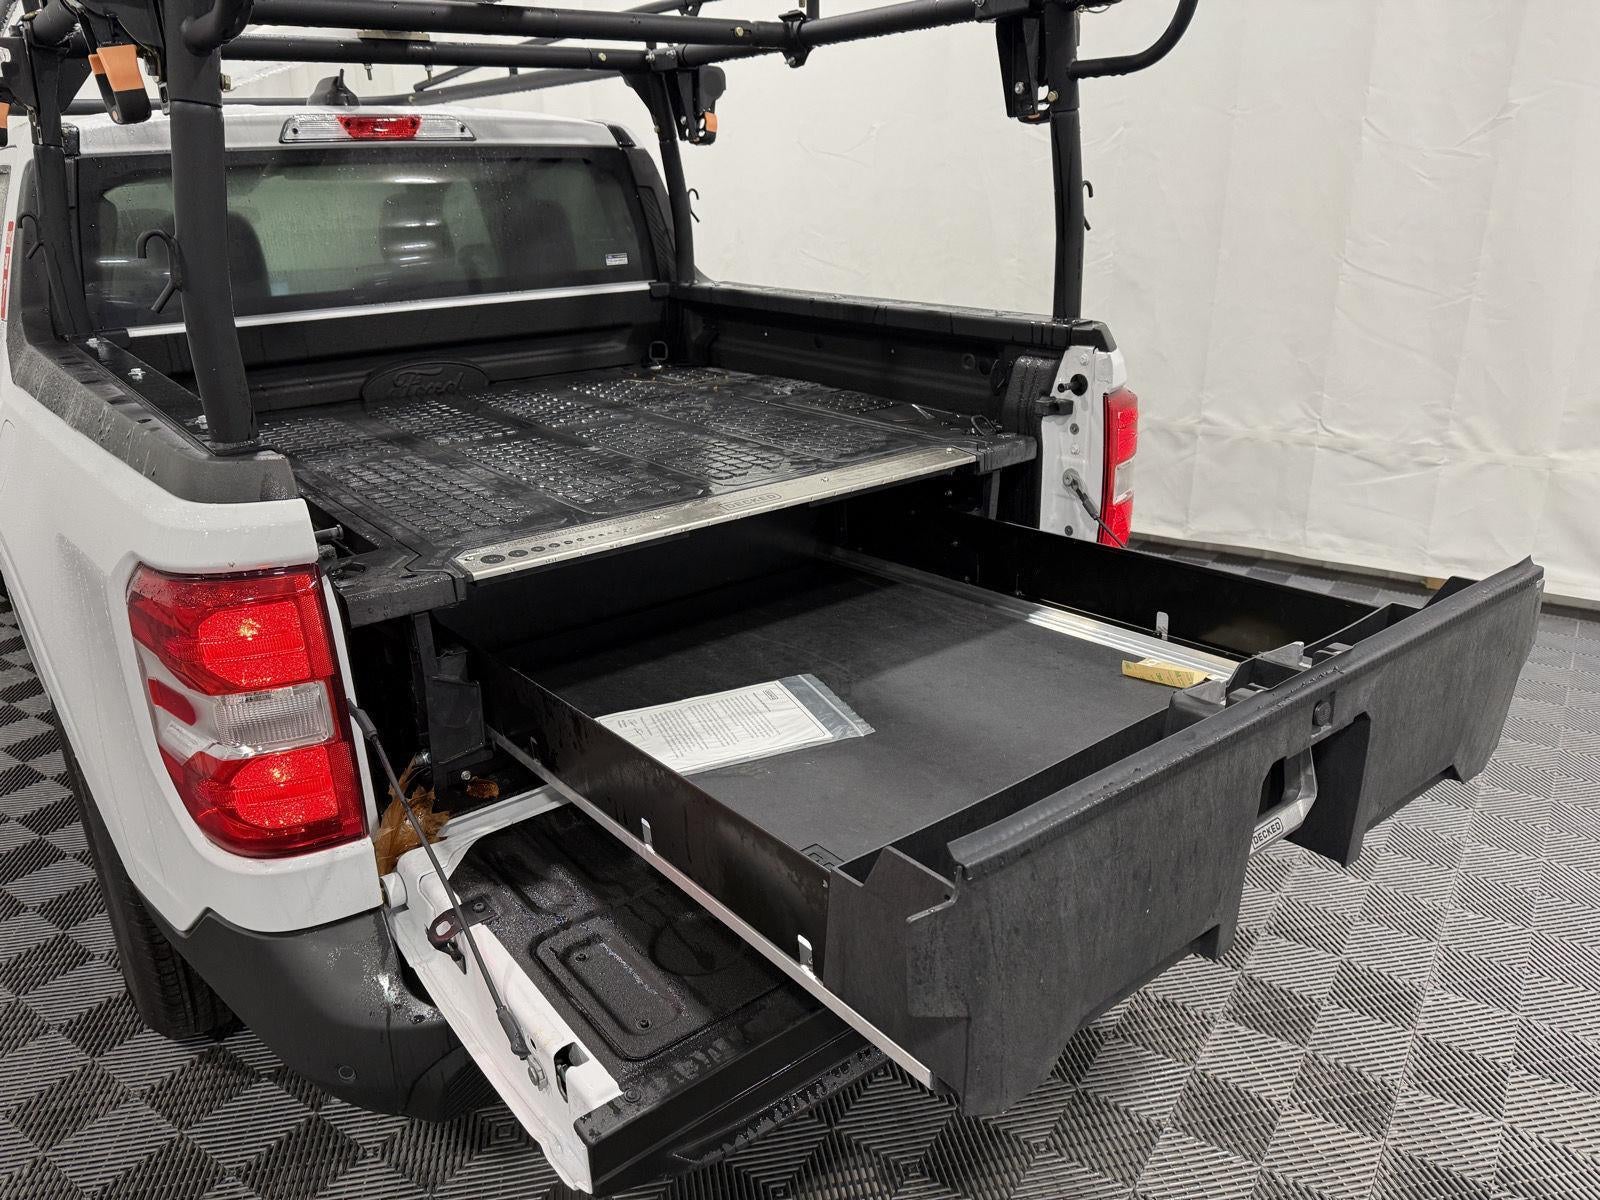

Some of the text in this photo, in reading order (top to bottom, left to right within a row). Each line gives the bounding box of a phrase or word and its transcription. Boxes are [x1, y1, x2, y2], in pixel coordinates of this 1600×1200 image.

[391, 367, 464, 397] Ford
[725, 494, 776, 509] DECKED
[1253, 821, 1281, 845] DECKED
